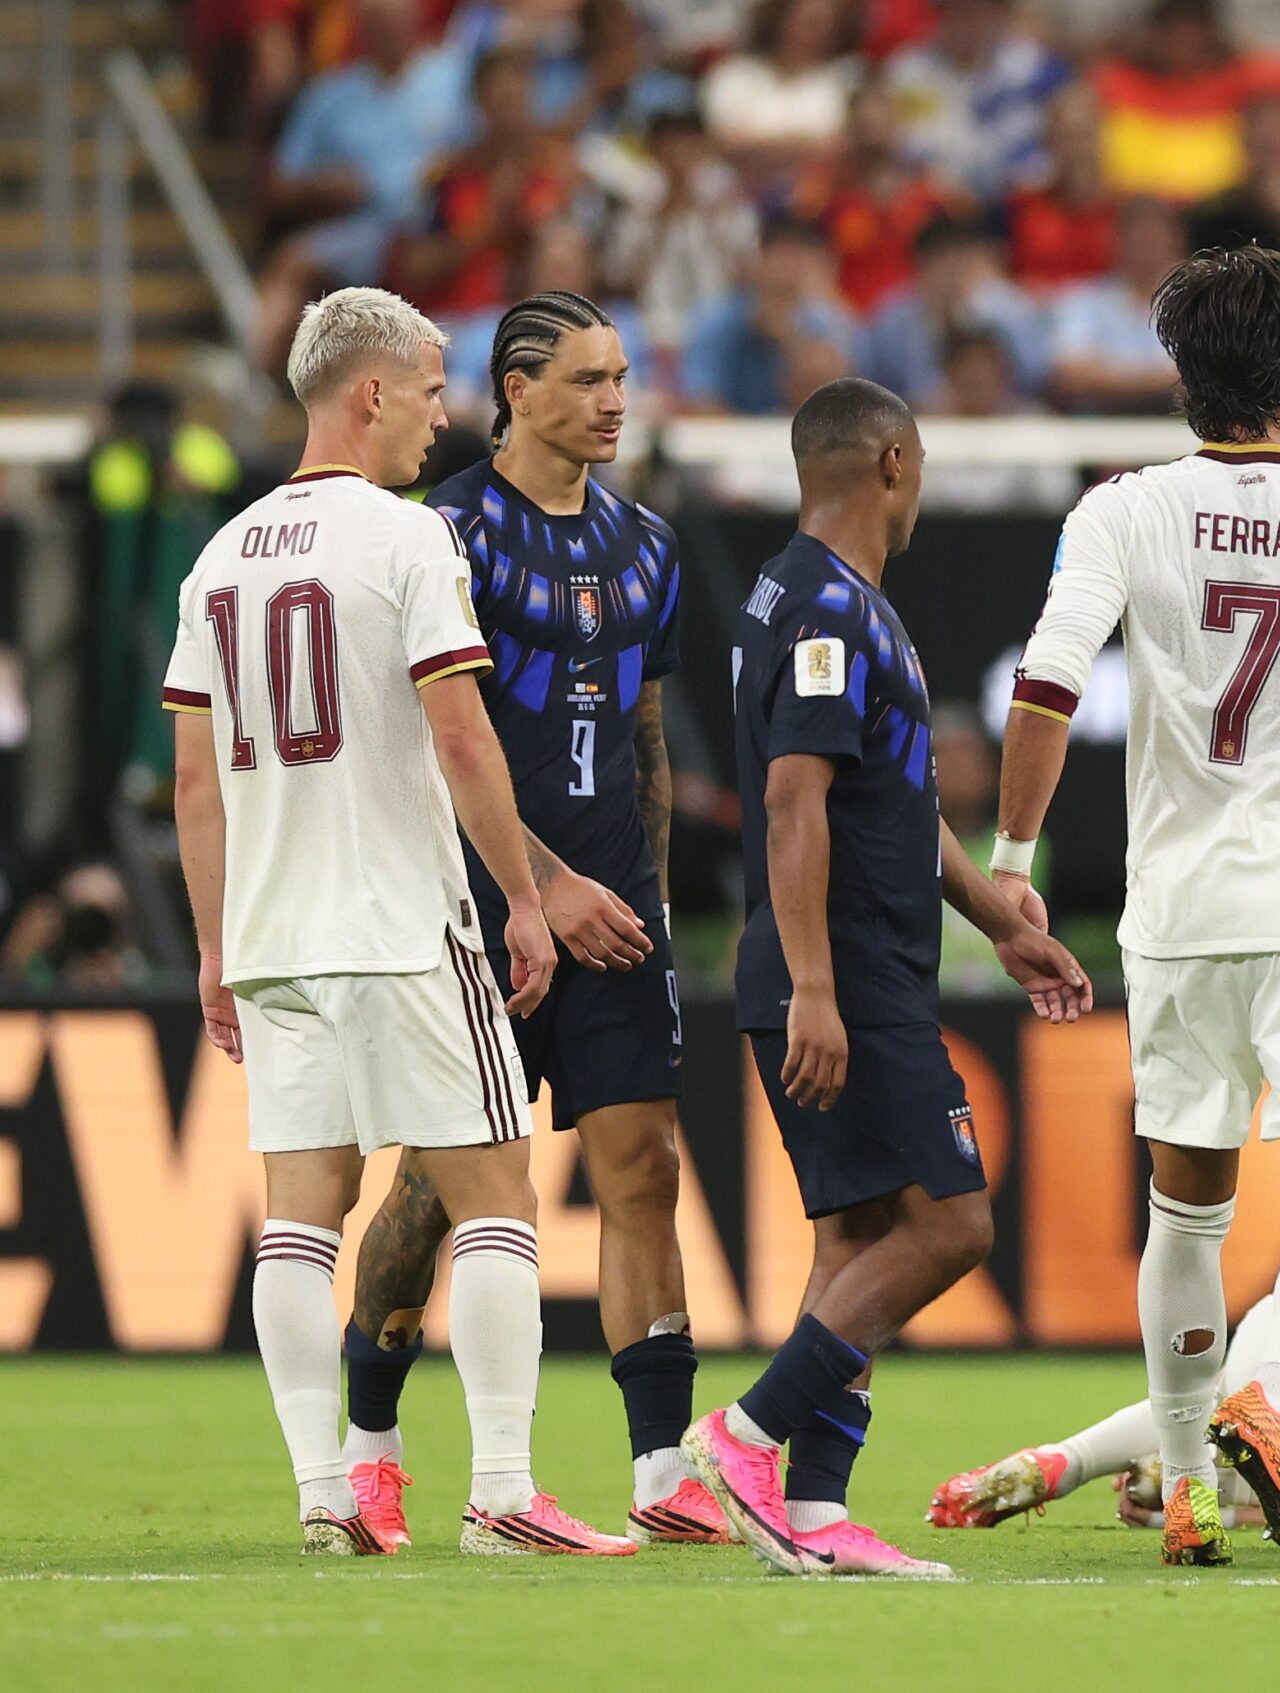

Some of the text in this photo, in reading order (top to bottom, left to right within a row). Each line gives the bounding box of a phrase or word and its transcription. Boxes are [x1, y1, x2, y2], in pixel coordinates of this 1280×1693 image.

[241, 520, 318, 559] OLMO
[205, 578, 344, 771] 10
[568, 719, 596, 796] 9
[665, 970, 683, 1046] 9
